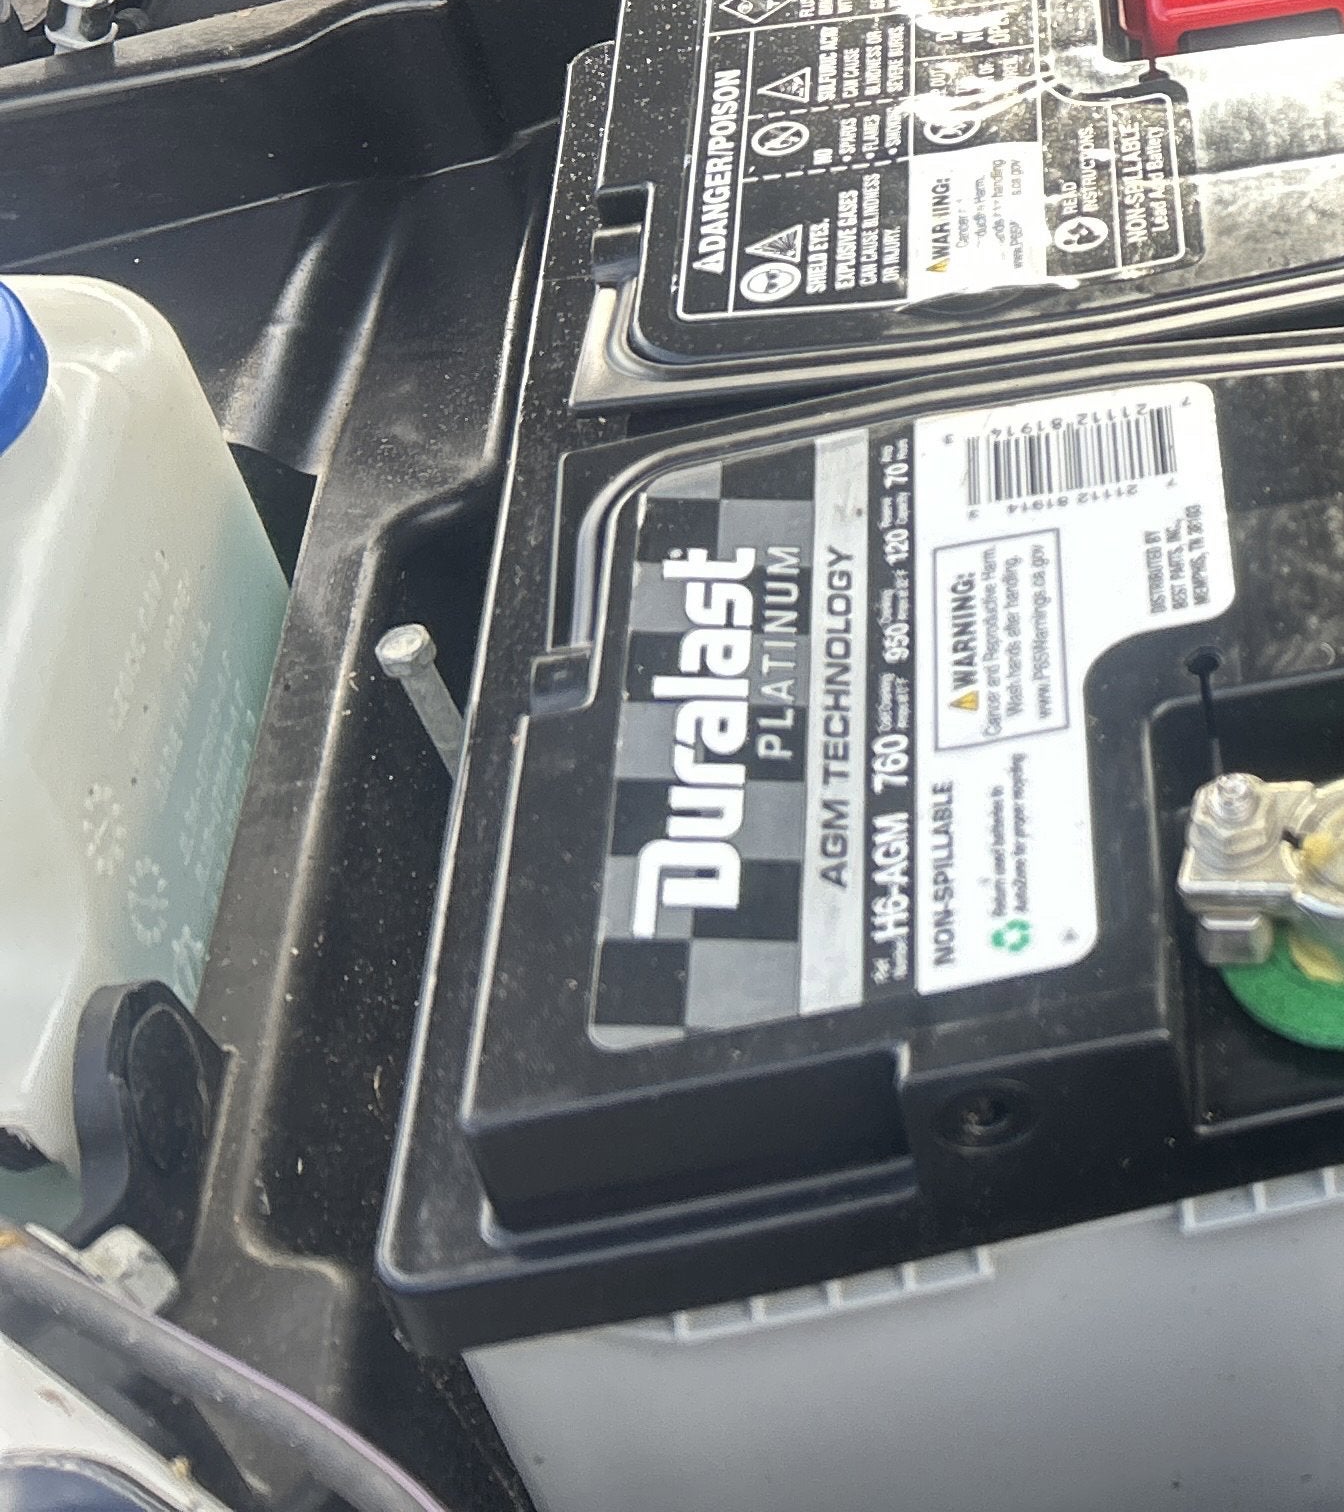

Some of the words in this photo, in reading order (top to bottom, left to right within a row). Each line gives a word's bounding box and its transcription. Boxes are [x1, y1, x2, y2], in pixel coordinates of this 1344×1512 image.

[820, 27, 839, 50] ACID
[866, 30, 882, 44] OR
[818, 53, 837, 102] SULFURIC
[843, 48, 860, 77] CAUSE
[865, 45, 882, 95] BLINDNESS
[887, 60, 904, 92] SEVERE
[842, 79, 859, 98] CAN
[697, 69, 742, 255] DANGER/POISON
[813, 148, 833, 165] NO
[1145, 126, 1165, 168] Battery
[837, 189, 858, 227] GASES
[862, 173, 881, 228] BLINDNESS
[1062, 182, 1078, 214] READ
[1150, 200, 1170, 232] Lead
[835, 228, 857, 290] EXPLOSIVE
[861, 230, 879, 261] CAUSE
[883, 225, 901, 265] INJURY.
[806, 252, 827, 294] SHIELD
[860, 262, 878, 285] CAN
[881, 266, 899, 283] OR
[883, 463, 909, 488] 70
[883, 528, 910, 566] 120
[1144, 531, 1160, 544] BY
[1146, 546, 1166, 614] DISTRIBUTED
[1170, 584, 1188, 610] BEST
[950, 572, 978, 690] WARNING:
[982, 583, 1002, 661] Reproductive
[1005, 611, 1020, 637] after
[1030, 544, 1052, 720] www.P65Warnings.ca.gov
[757, 545, 801, 760] PLATINUM
[882, 622, 910, 663] 950
[1006, 640, 1022, 677] hands
[821, 545, 854, 785] TECHNOLOGY
[984, 664, 1001, 687] and
[983, 690, 1003, 736] Cancer
[1005, 678, 1023, 717] Wash
[631, 546, 756, 938] Duralast
[870, 735, 910, 795] 760
[821, 799, 850, 888] AGM
[871, 811, 910, 942] H6-AGM
[931, 782, 954, 966] NON-SPILLABLE
